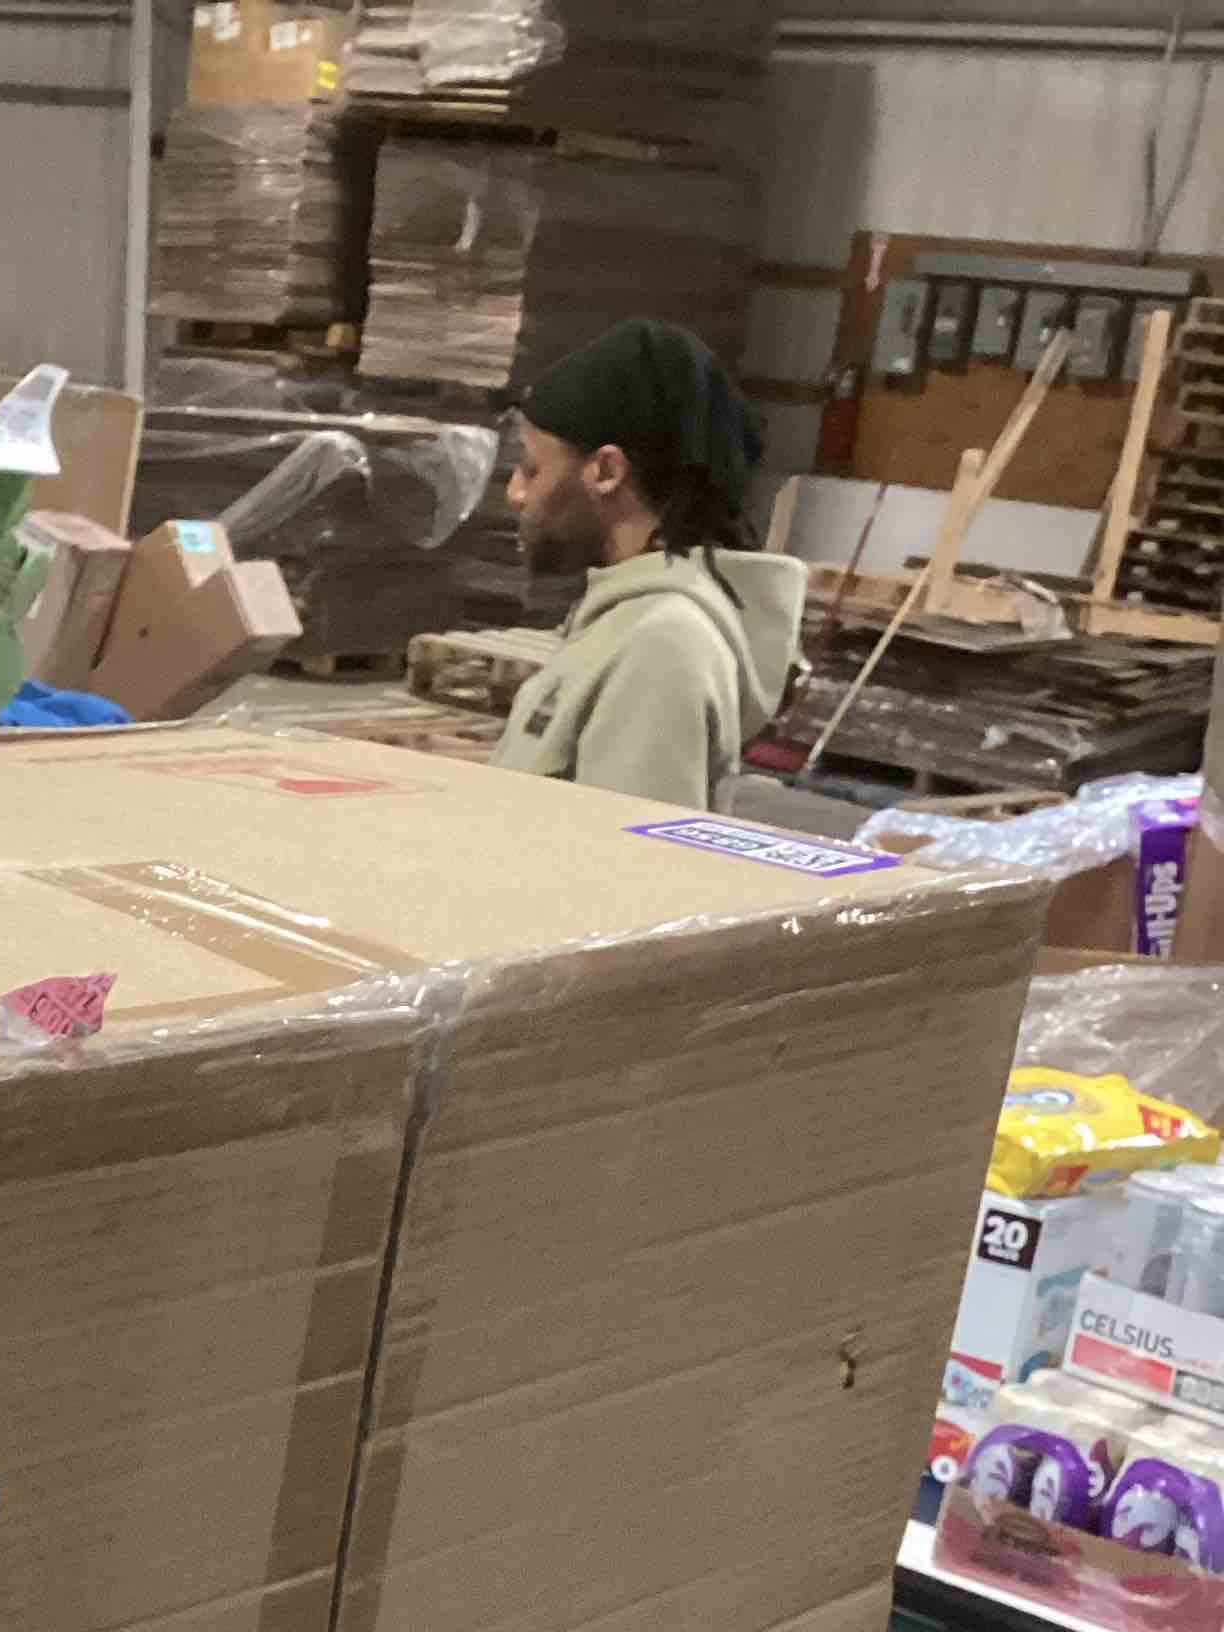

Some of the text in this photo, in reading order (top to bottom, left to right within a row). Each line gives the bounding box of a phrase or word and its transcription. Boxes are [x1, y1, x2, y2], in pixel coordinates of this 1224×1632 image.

[1144, 861, 1184, 960] ll-Ups
[983, 1215, 1030, 1250] 20
[1079, 1308, 1175, 1359] CELSIUS
